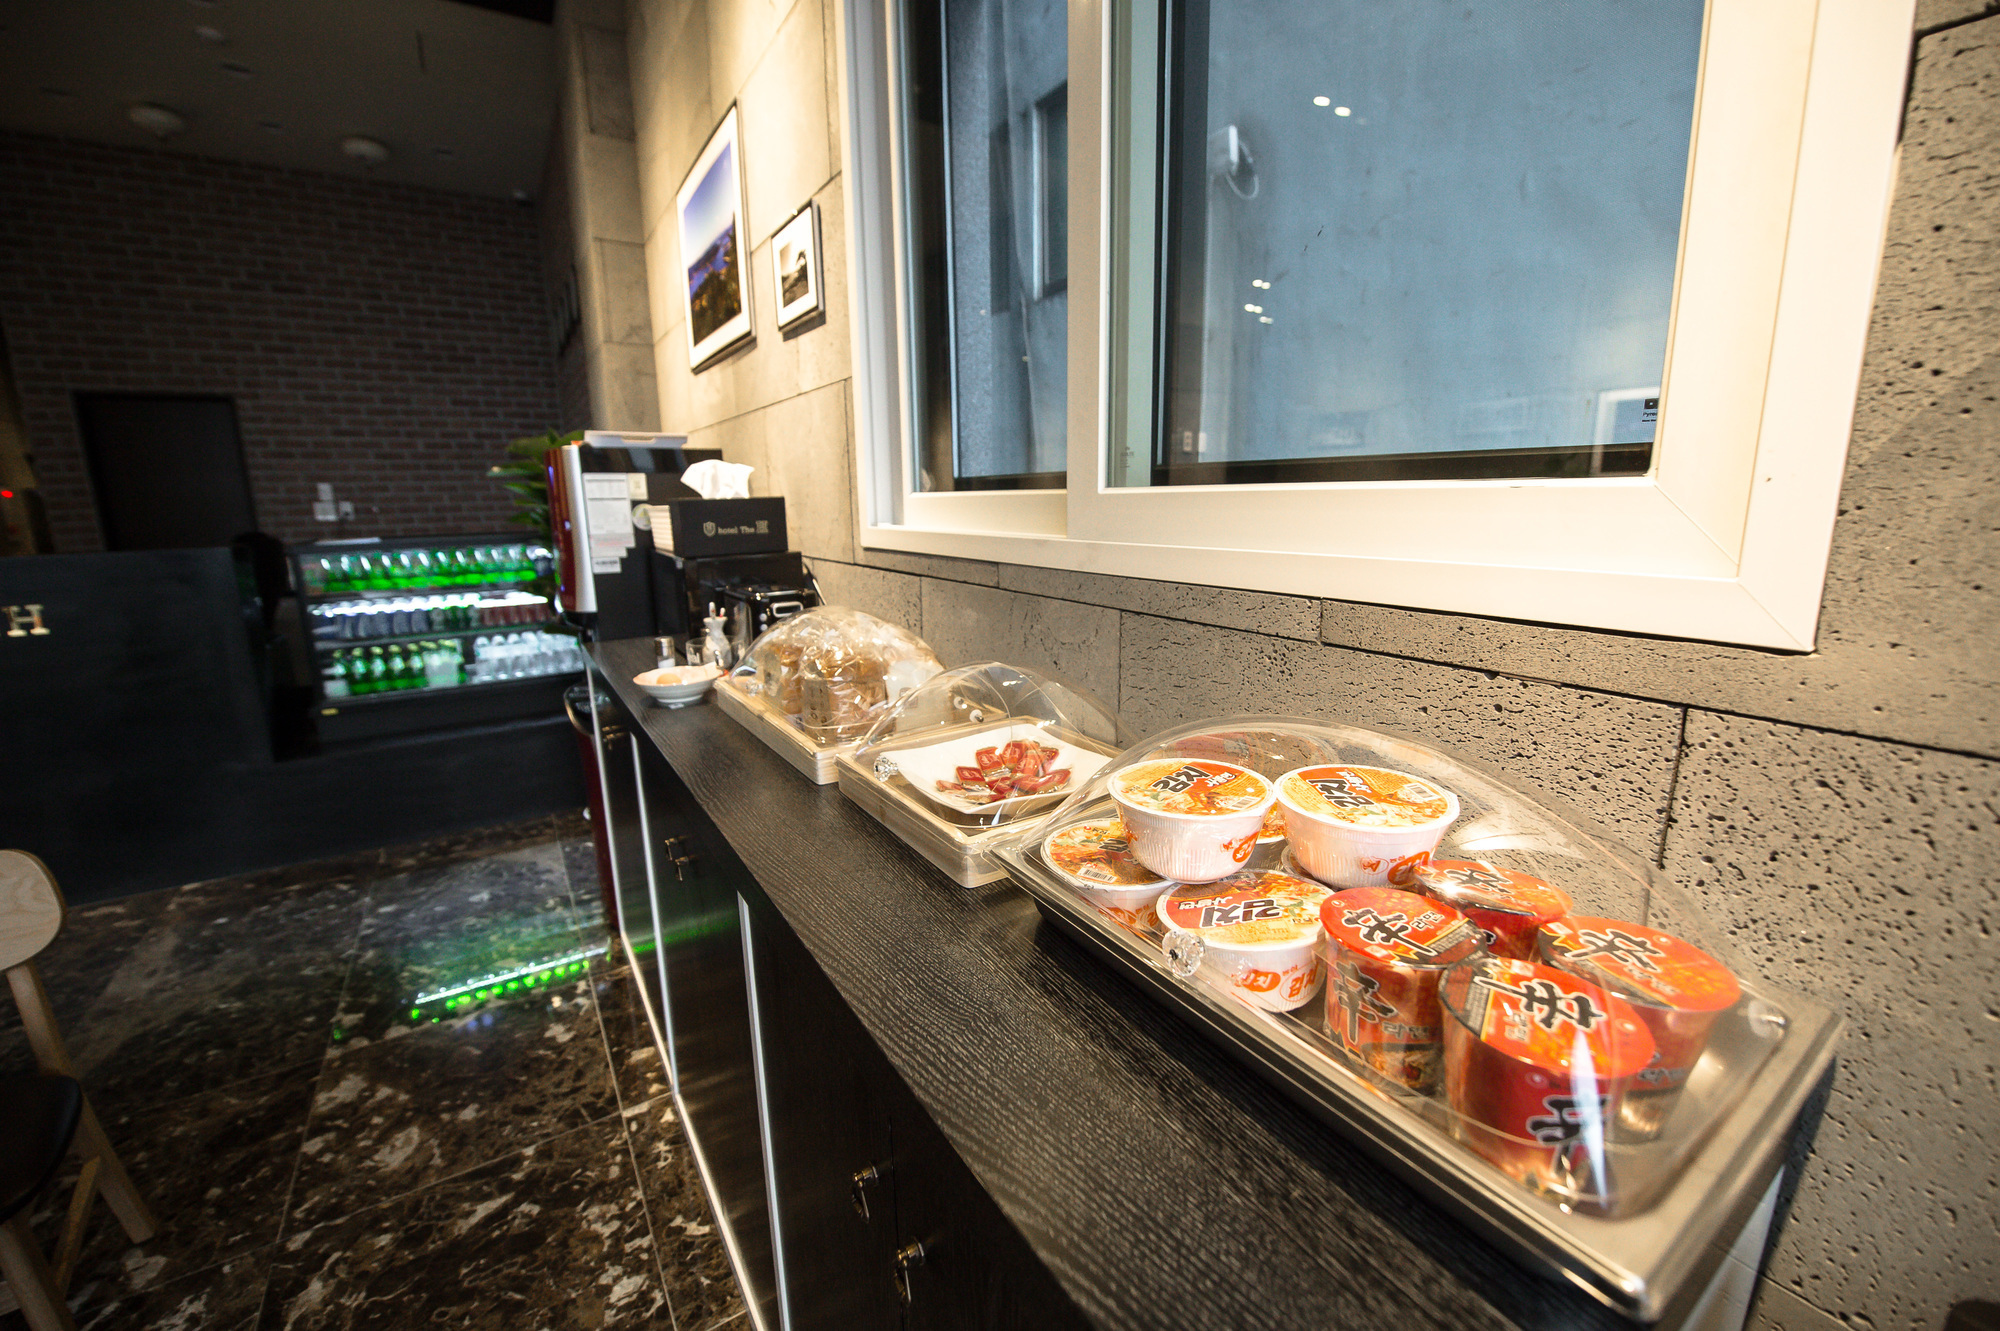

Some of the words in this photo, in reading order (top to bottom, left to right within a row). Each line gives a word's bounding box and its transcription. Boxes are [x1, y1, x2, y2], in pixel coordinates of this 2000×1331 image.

[1, 604, 50, 637] H
[1151, 765, 1212, 793] 김치
[1306, 778, 1375, 808] 김치
[1178, 896, 1233, 910] 사발면
[1199, 898, 1283, 928] 김치
[1342, 907, 1438, 956] 辛
[1410, 910, 1446, 930] 라면
[1565, 928, 1666, 974] 辛
[1333, 960, 1398, 1045] 辛
[1473, 976, 1608, 1032] 辛
